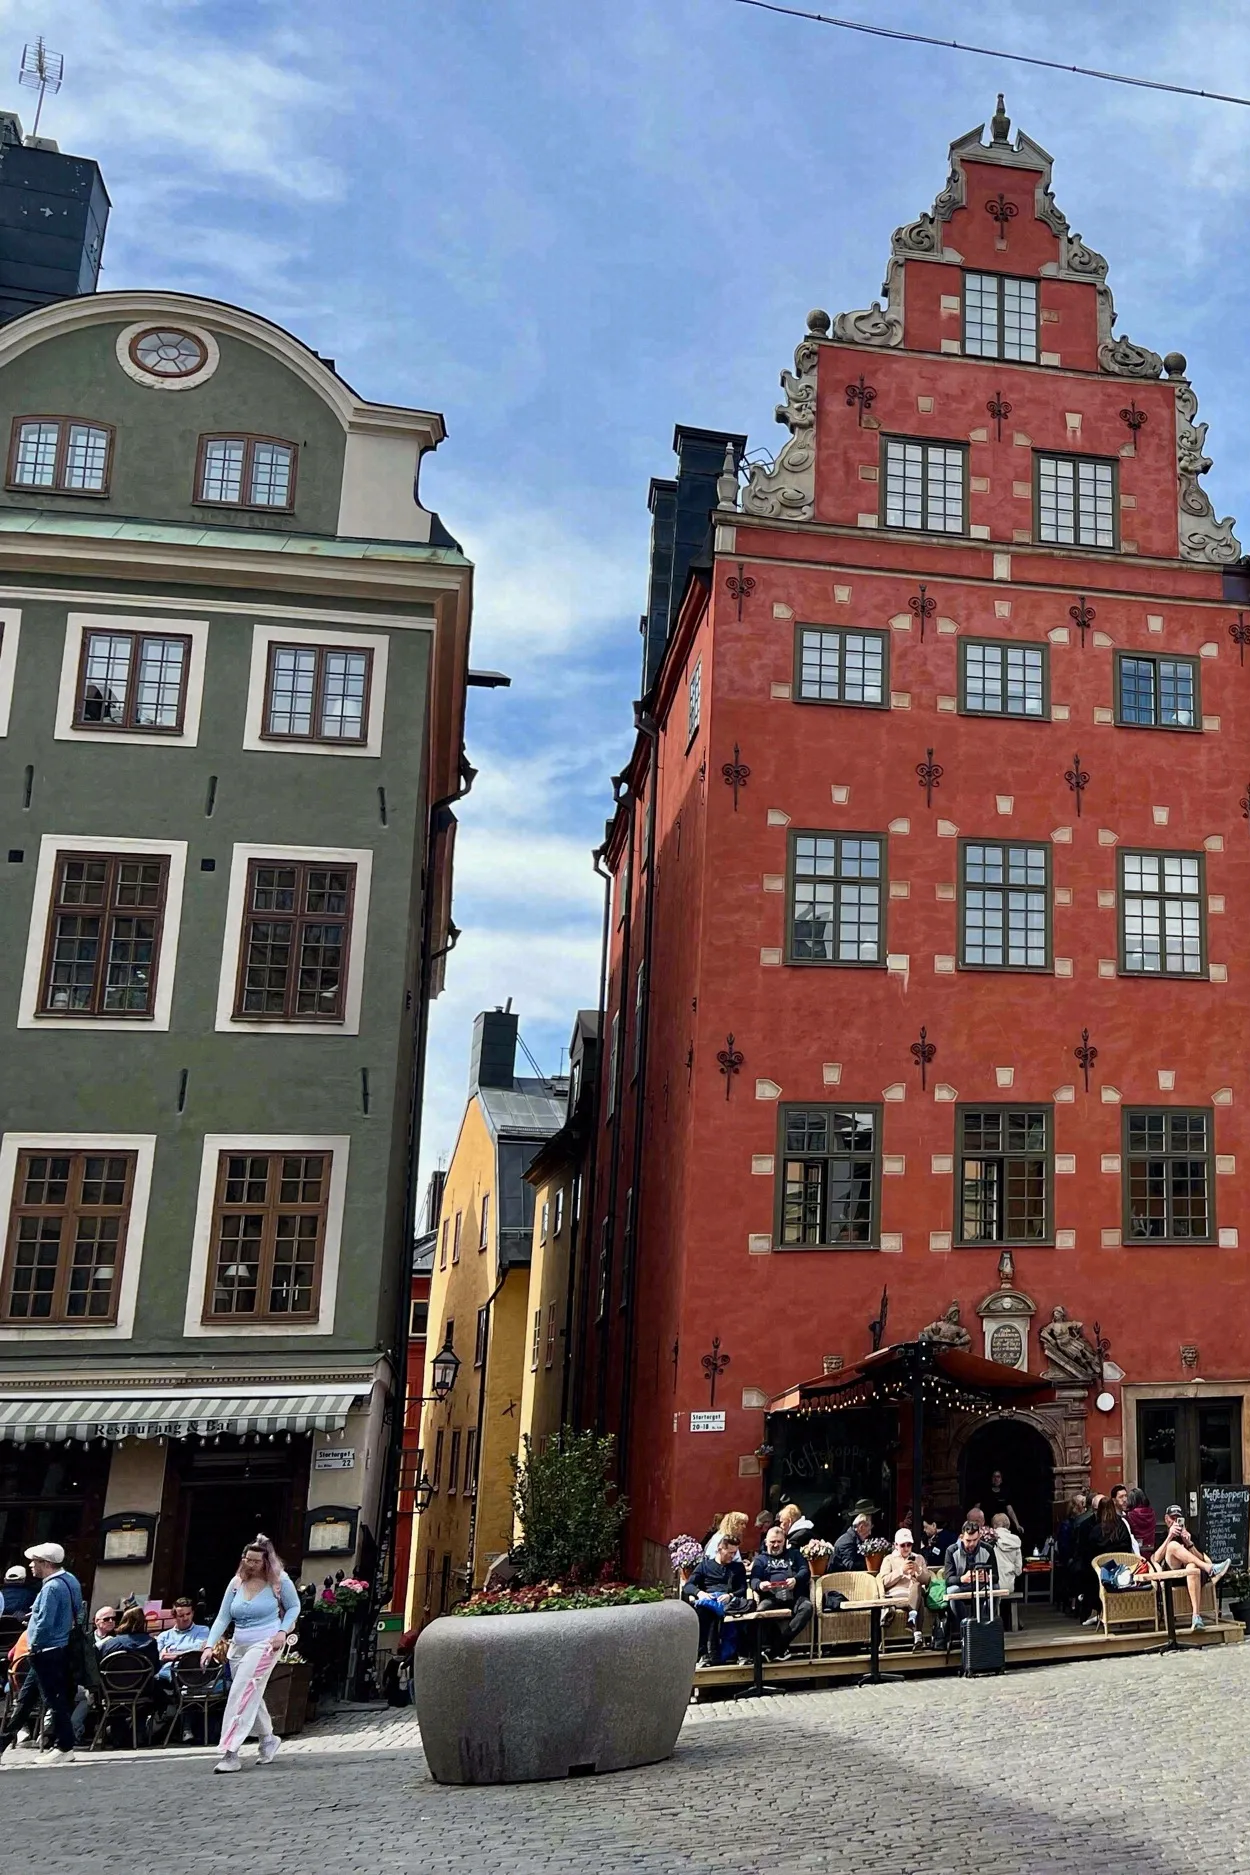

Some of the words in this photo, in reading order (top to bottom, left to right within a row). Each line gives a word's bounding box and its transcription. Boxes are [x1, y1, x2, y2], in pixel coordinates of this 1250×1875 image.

[94, 1423, 182, 1436] Restaurang
[187, 1421, 199, 1432] &
[205, 1420, 232, 1432] Bar
[319, 1451, 351, 1459] Stortorget
